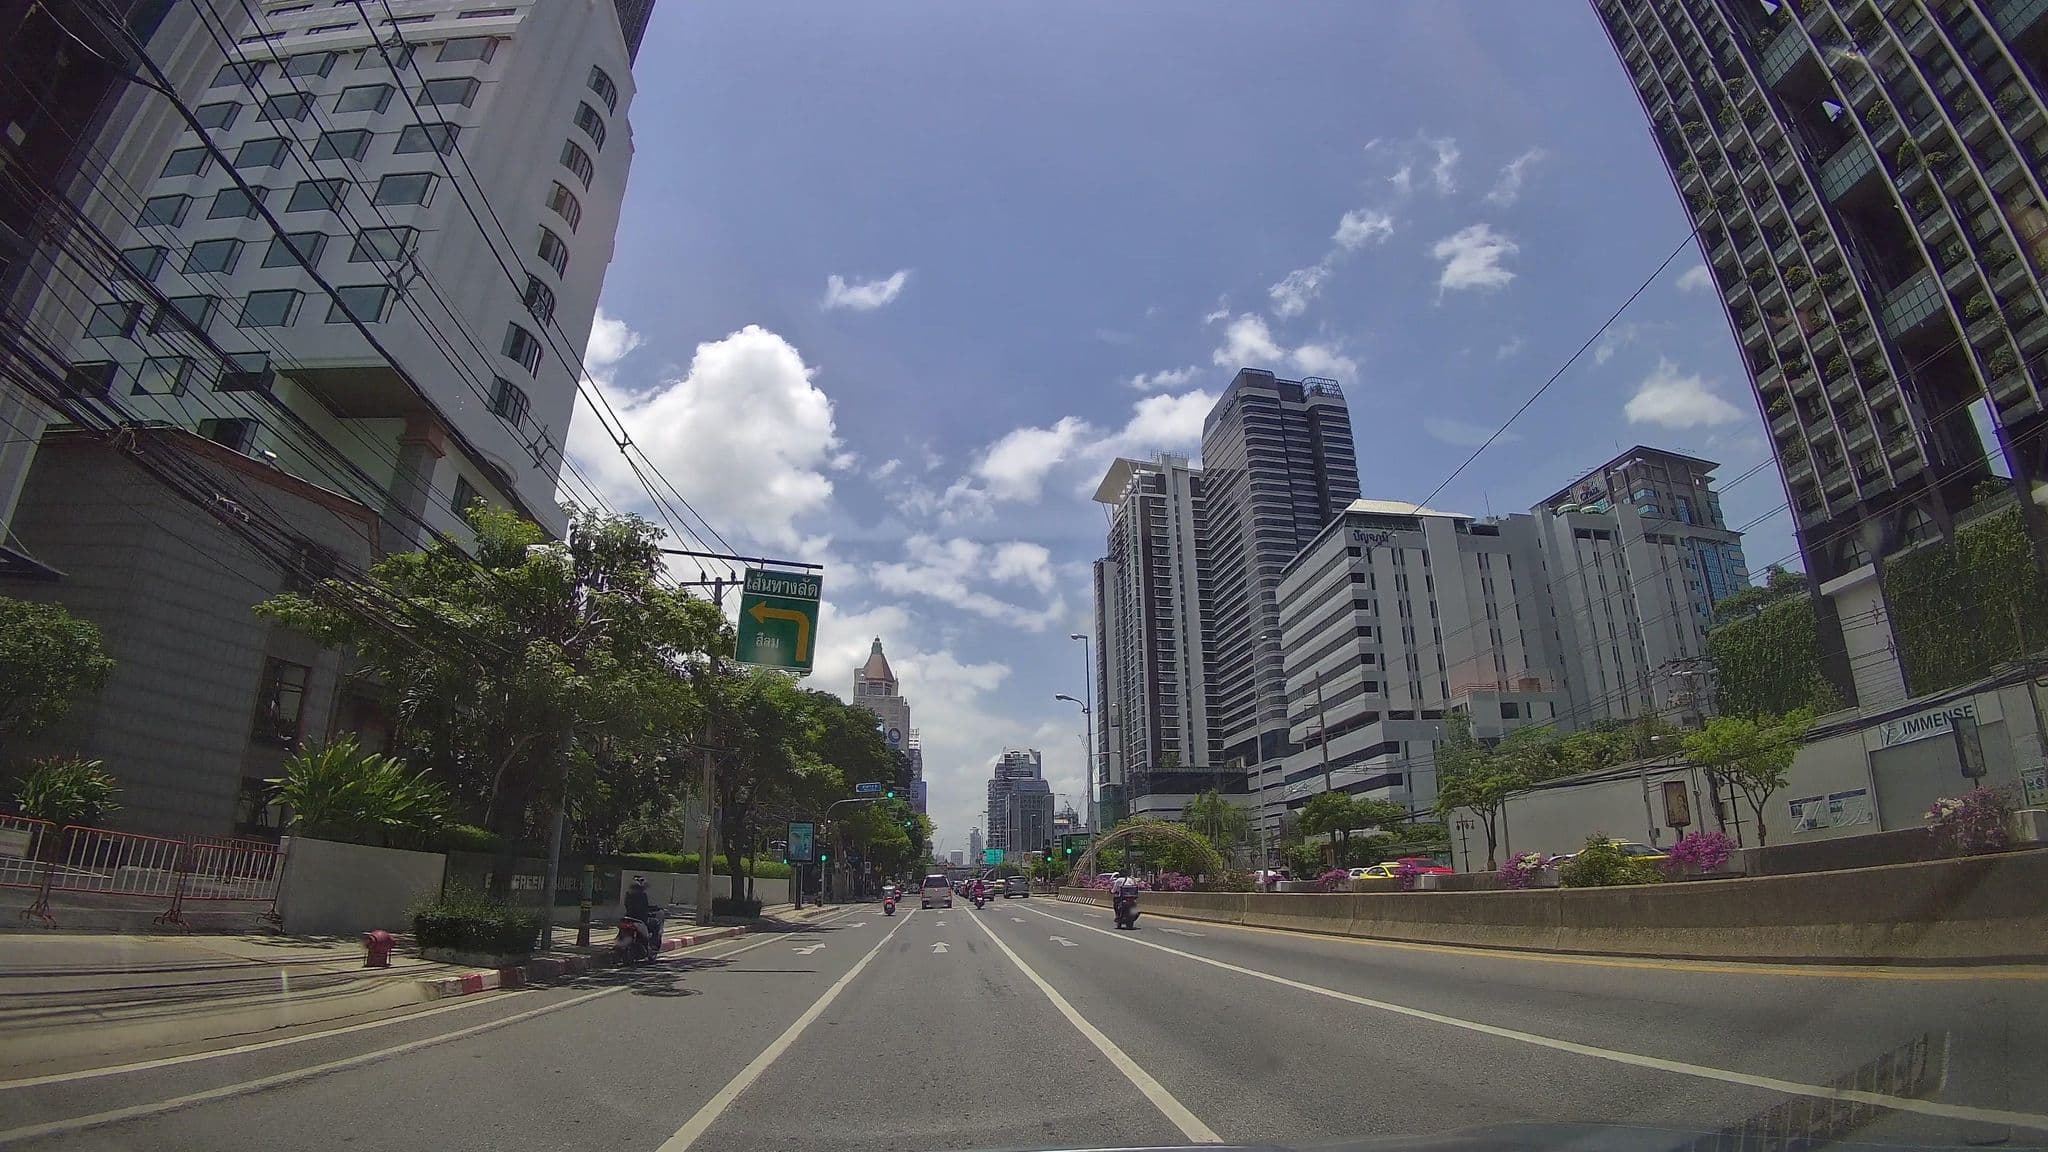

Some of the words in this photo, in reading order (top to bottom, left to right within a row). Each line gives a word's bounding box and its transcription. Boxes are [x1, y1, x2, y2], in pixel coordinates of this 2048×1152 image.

[746, 572, 818, 597] เส้นทางลัด
[755, 632, 780, 649] สีลม
[1902, 704, 1975, 735] IMMENSE
